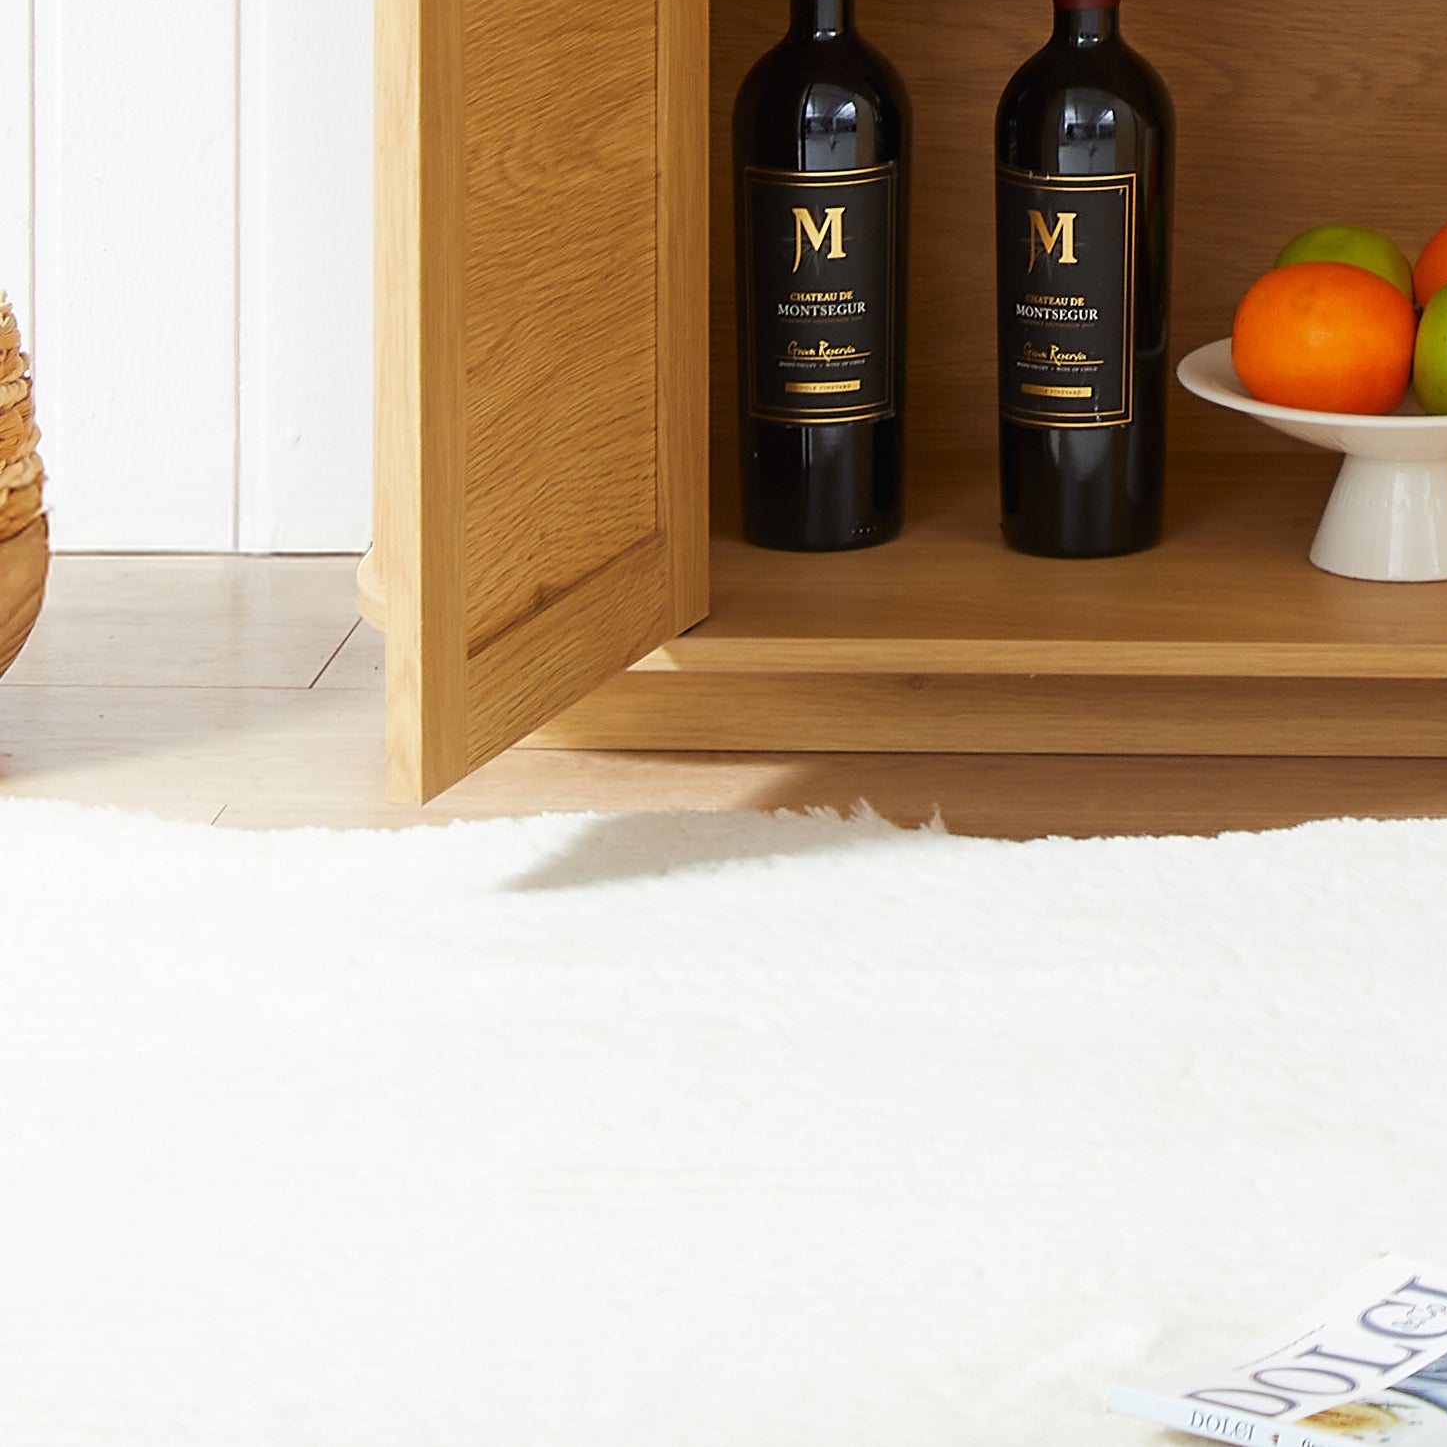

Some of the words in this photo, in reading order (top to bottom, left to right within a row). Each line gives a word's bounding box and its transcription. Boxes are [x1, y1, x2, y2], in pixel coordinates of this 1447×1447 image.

[792, 206, 847, 274] M
[1027, 209, 1078, 275] M
[790, 292, 838, 302] CHATEAU
[839, 290, 854, 301] DE
[1070, 297, 1085, 306] DE
[777, 301, 866, 317] MONTSEGUR
[1016, 304, 1099, 321] MONTSEGUR
[1190, 1410, 1256, 1442] DOLCI
